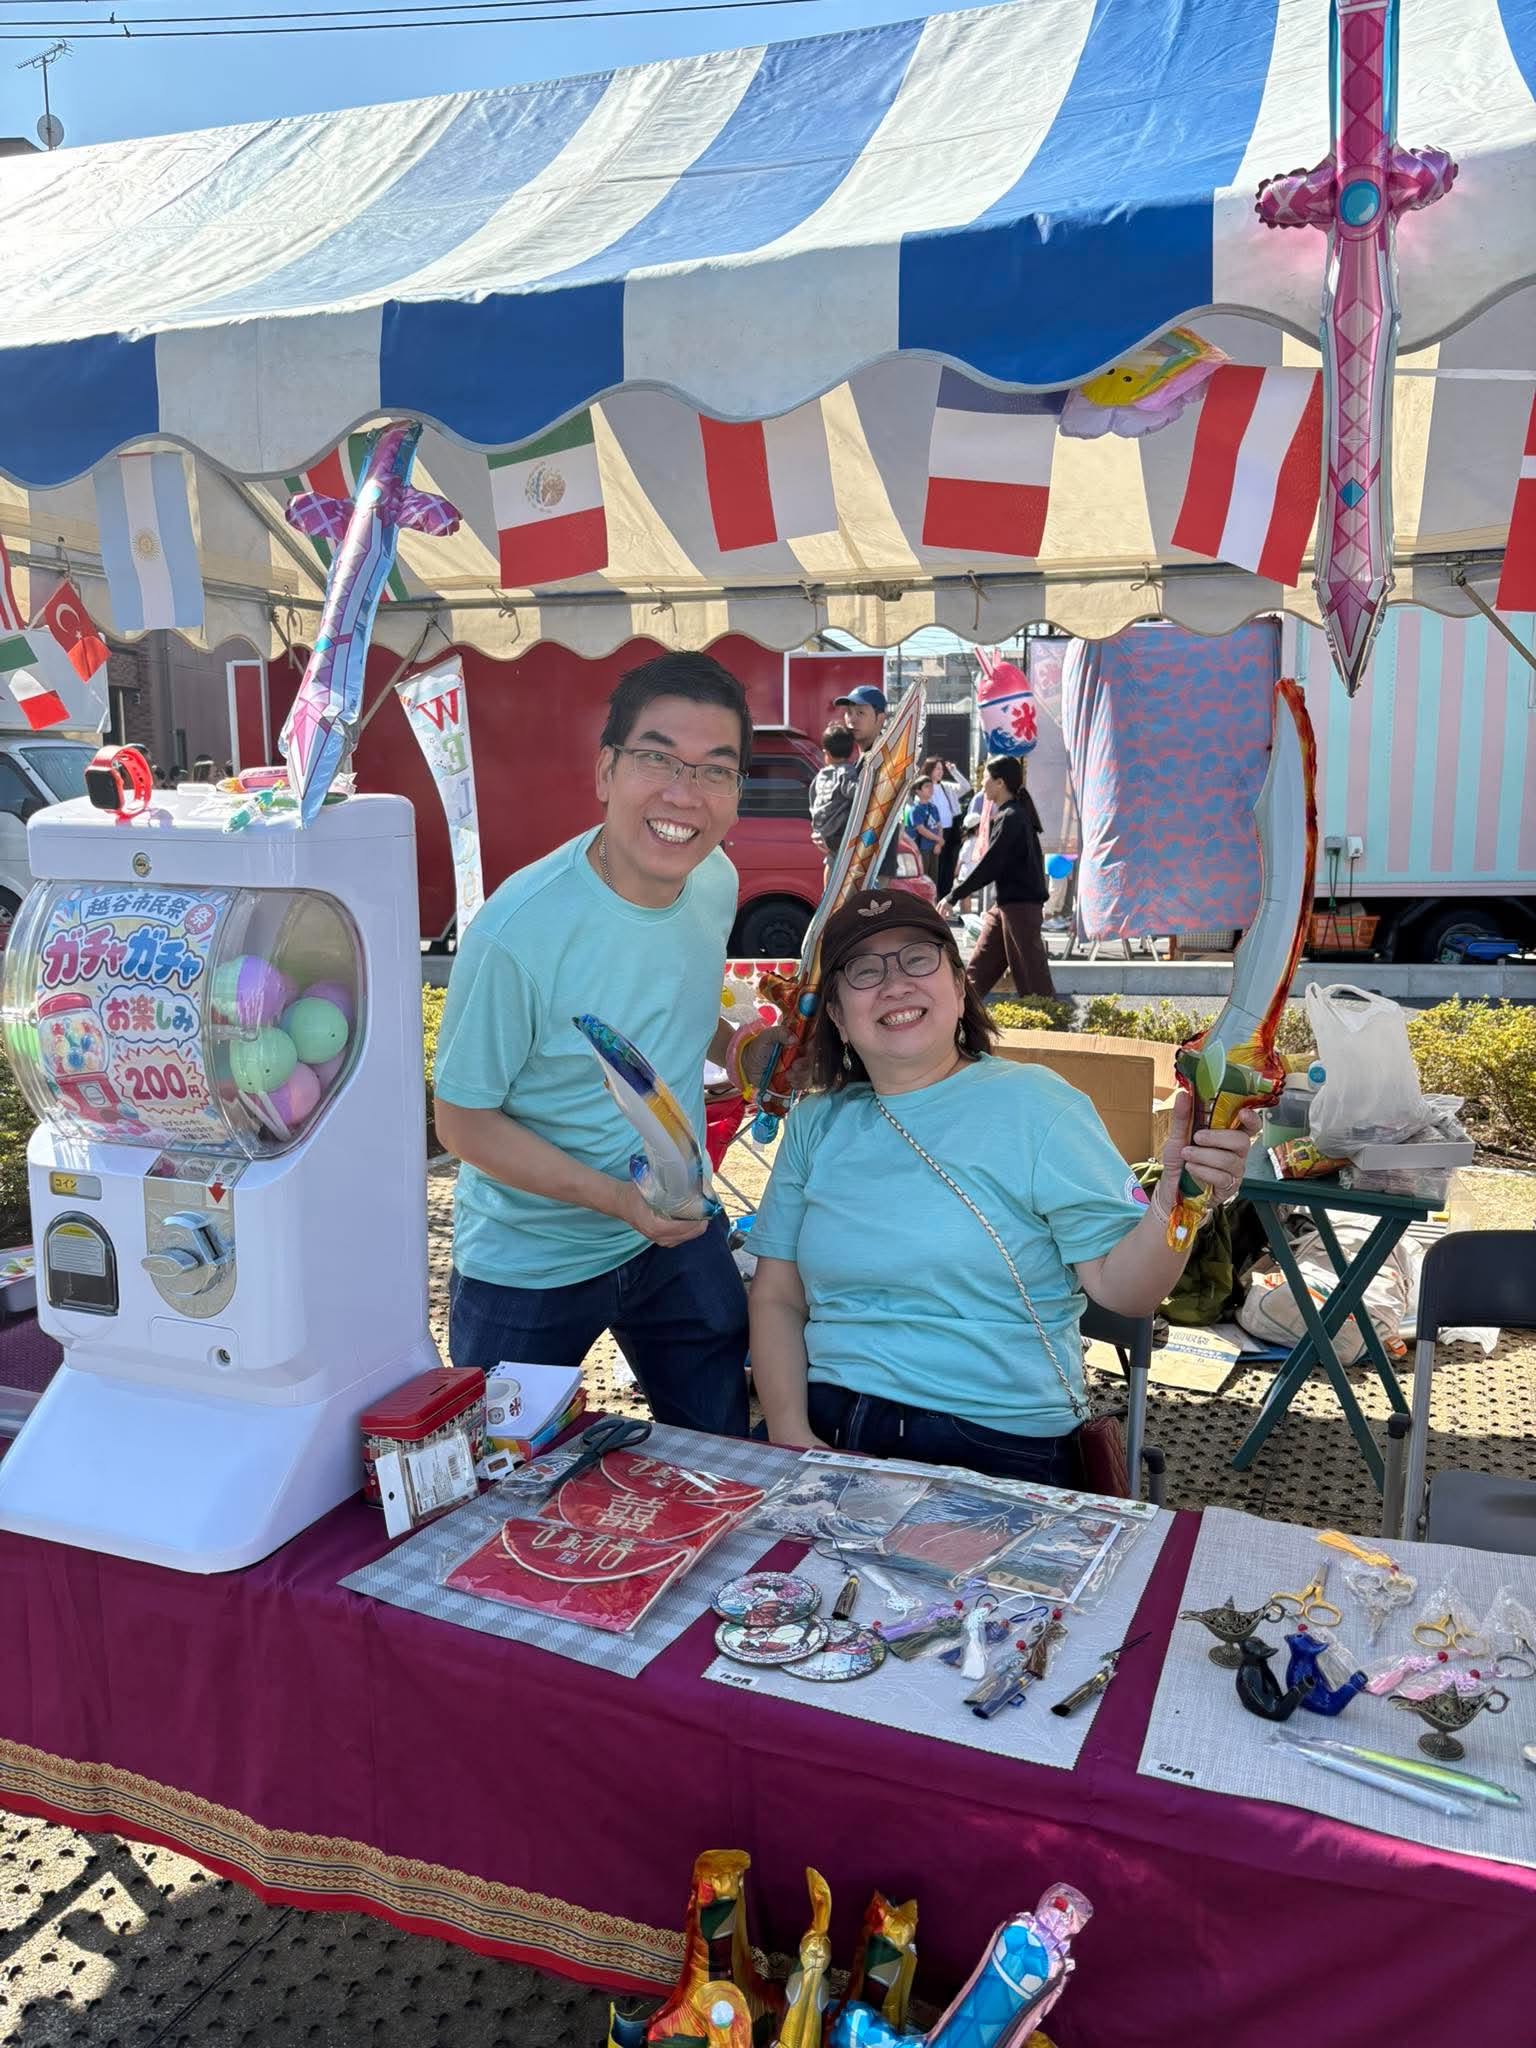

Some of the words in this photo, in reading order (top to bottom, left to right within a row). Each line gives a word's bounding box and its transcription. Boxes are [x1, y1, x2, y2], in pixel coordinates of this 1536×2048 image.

[1011, 702, 1038, 741] 氷
[85, 892, 191, 920] 越谷市民祭
[44, 926, 202, 986] ガチャガチャ
[106, 994, 194, 1032] お楽しみ
[55, 1178, 77, 1189] コイン
